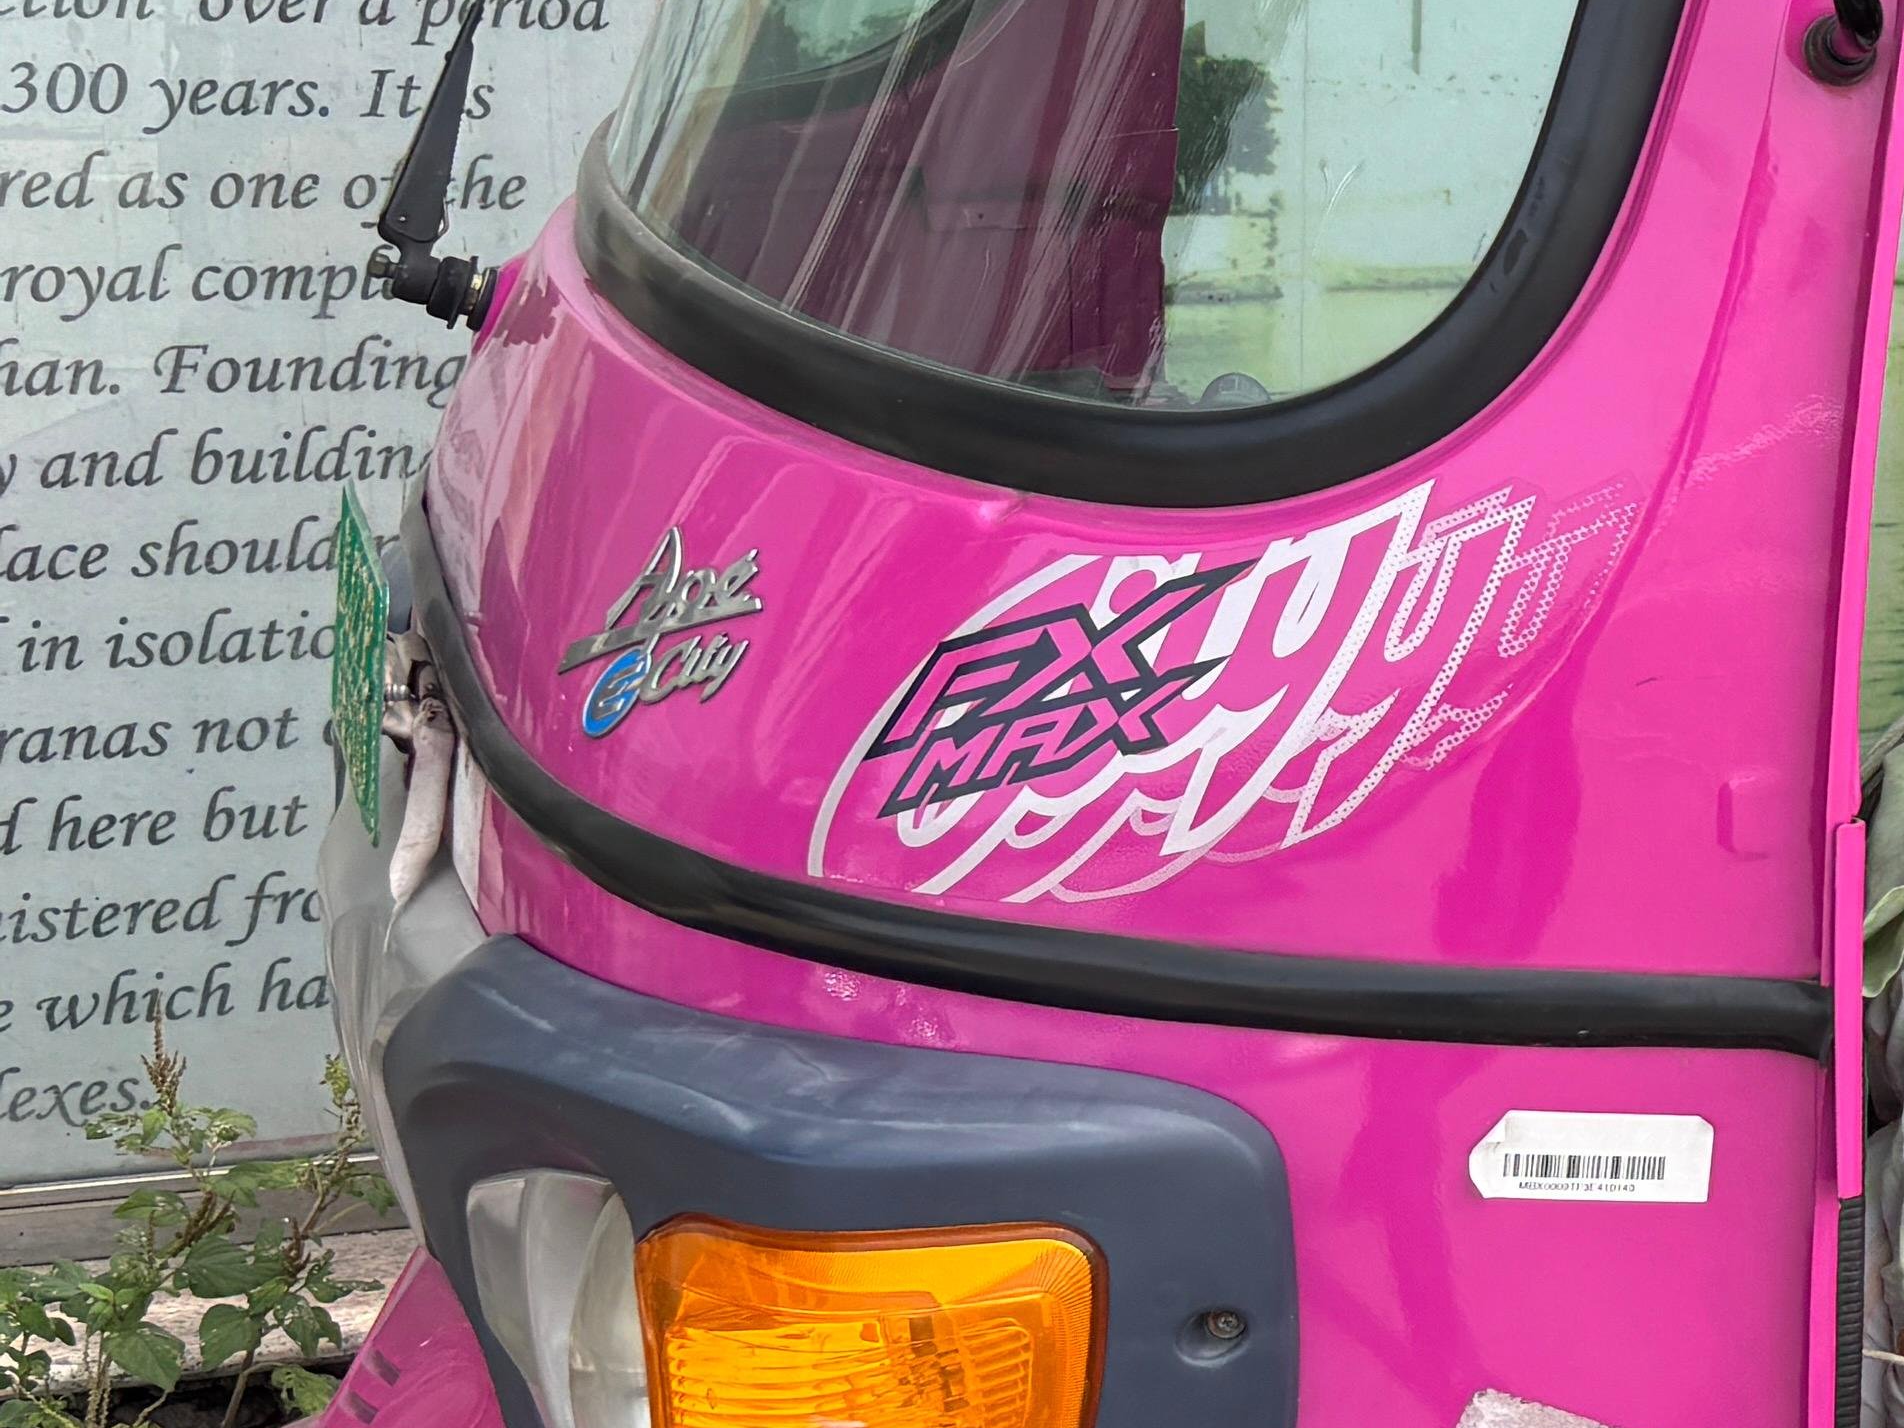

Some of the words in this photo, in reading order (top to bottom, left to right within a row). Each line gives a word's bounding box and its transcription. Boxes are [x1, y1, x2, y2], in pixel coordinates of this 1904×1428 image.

[3, 61, 128, 114] 300
[143, 78, 332, 135] years.
[360, 67, 422, 120] It
[117, 169, 189, 211] as
[210, 171, 320, 211] one
[446, 153, 527, 211] he
[3, 243, 183, 323] royal
[154, 334, 467, 409] Founding
[41, 428, 179, 489] and
[191, 424, 433, 484] buildin
[131, 513, 342, 577] should
[18, 621, 84, 675] in
[194, 707, 300, 756] not
[882, 657, 1220, 815] MAX
[48, 796, 177, 853] here
[203, 785, 309, 843] but
[36, 961, 234, 1032] which
